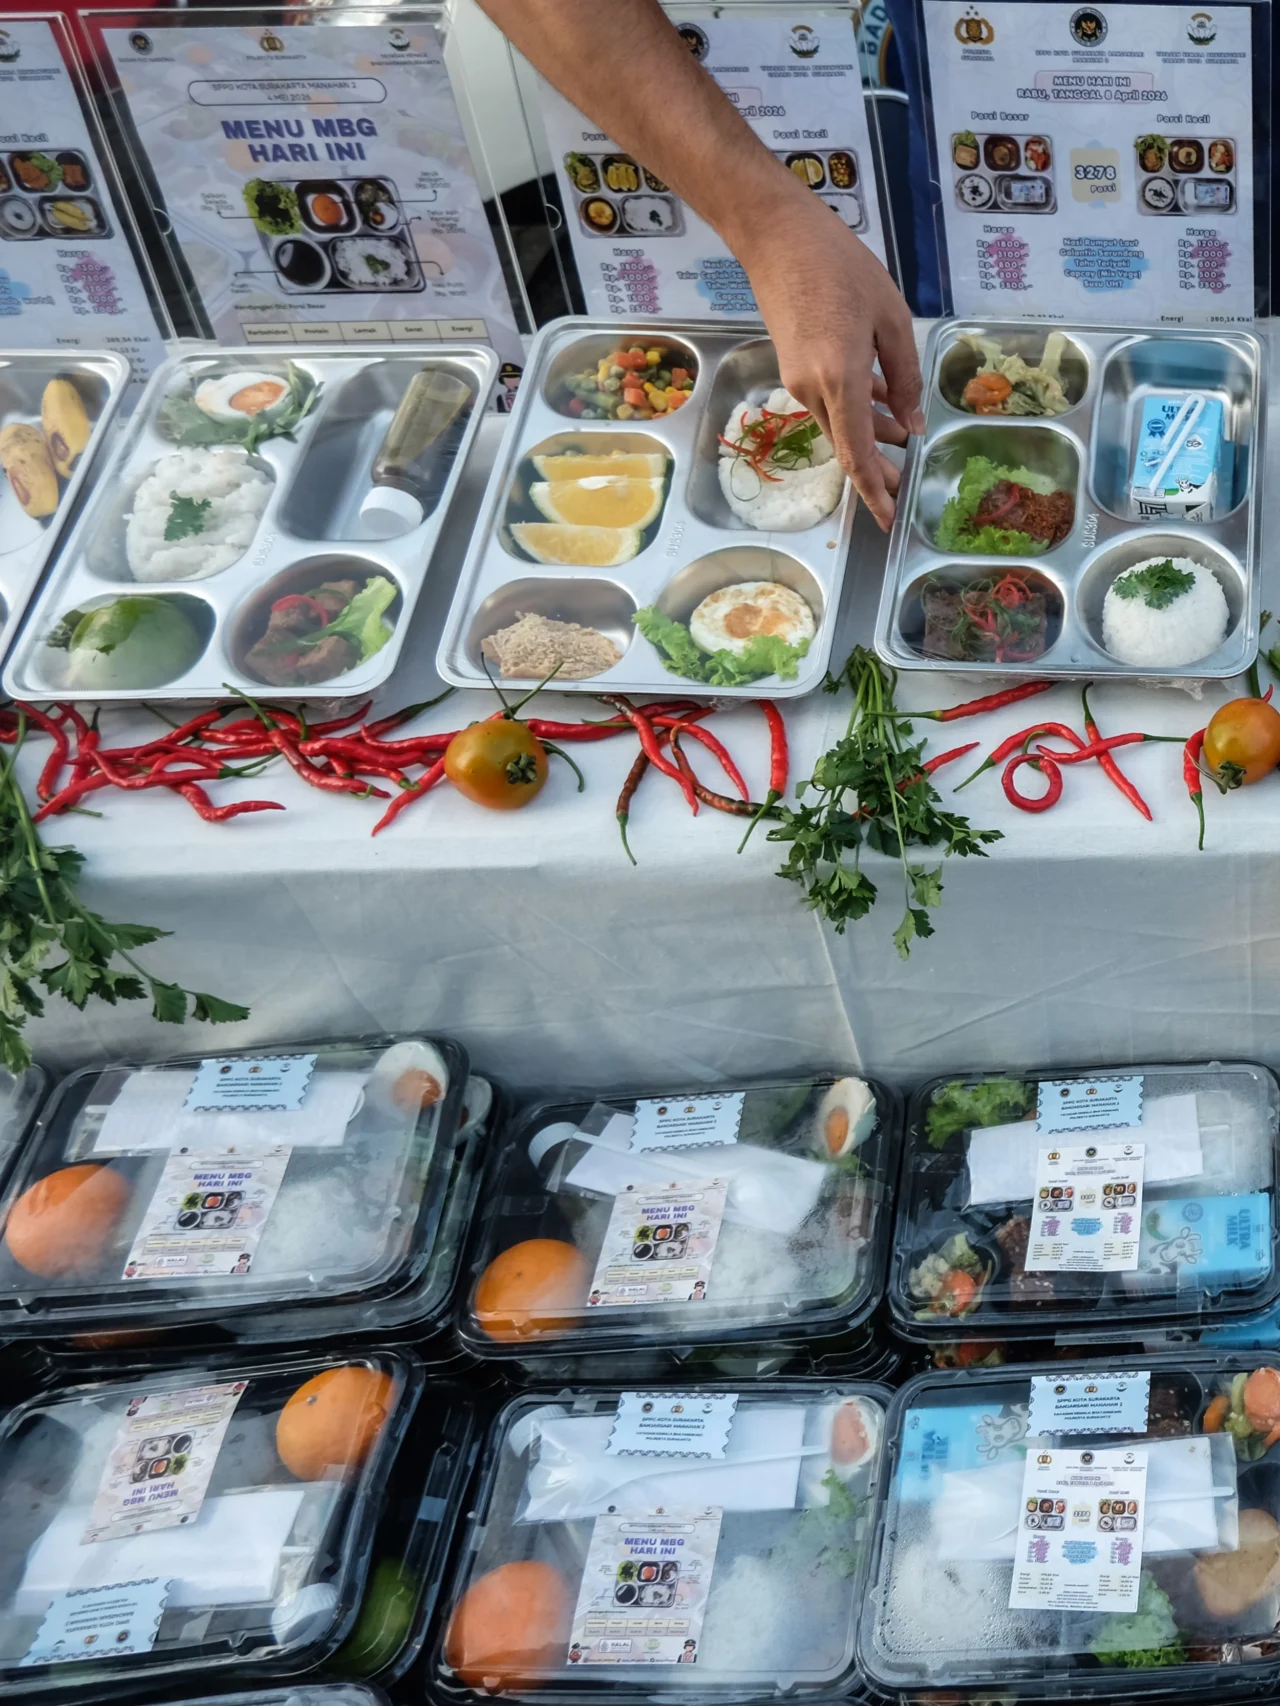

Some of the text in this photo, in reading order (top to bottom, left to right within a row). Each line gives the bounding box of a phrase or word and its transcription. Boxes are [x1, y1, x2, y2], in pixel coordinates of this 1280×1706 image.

[1053, 76, 1132, 87] MENU HARI INI
[1017, 88, 1050, 101] RABU,
[1052, 89, 1103, 100] TANGGAL
[1114, 90, 1140, 102] April
[1141, 91, 1168, 101] 2026
[758, 107, 786, 119] 2026
[971, 112, 1030, 121] Porsi Besar
[1157, 115, 1211, 124] Porsi Kecil
[221, 118, 378, 140] MENU MBG
[774, 131, 829, 141] Porsi Kecil
[248, 142, 367, 163] HARI INI
[1075, 165, 1117, 181] 3278
[1090, 183, 1117, 193] Porsi
[984, 225, 1015, 235] Harga
[1186, 227, 1217, 238] Harga
[1063, 238, 1082, 247] Nasi
[1084, 238, 1118, 249] Rumput
[613, 249, 645, 258] Harga
[1075, 259, 1095, 268] Tahu
[1064, 270, 1096, 281] Capcay
[193, 1172, 225, 1181] MENU
[1226, 1215, 1238, 1246] MILK
[1239, 1209, 1251, 1250] ULTRA
[624, 1537, 685, 1546] MENU MBG
[630, 1546, 677, 1555] HARI INI
